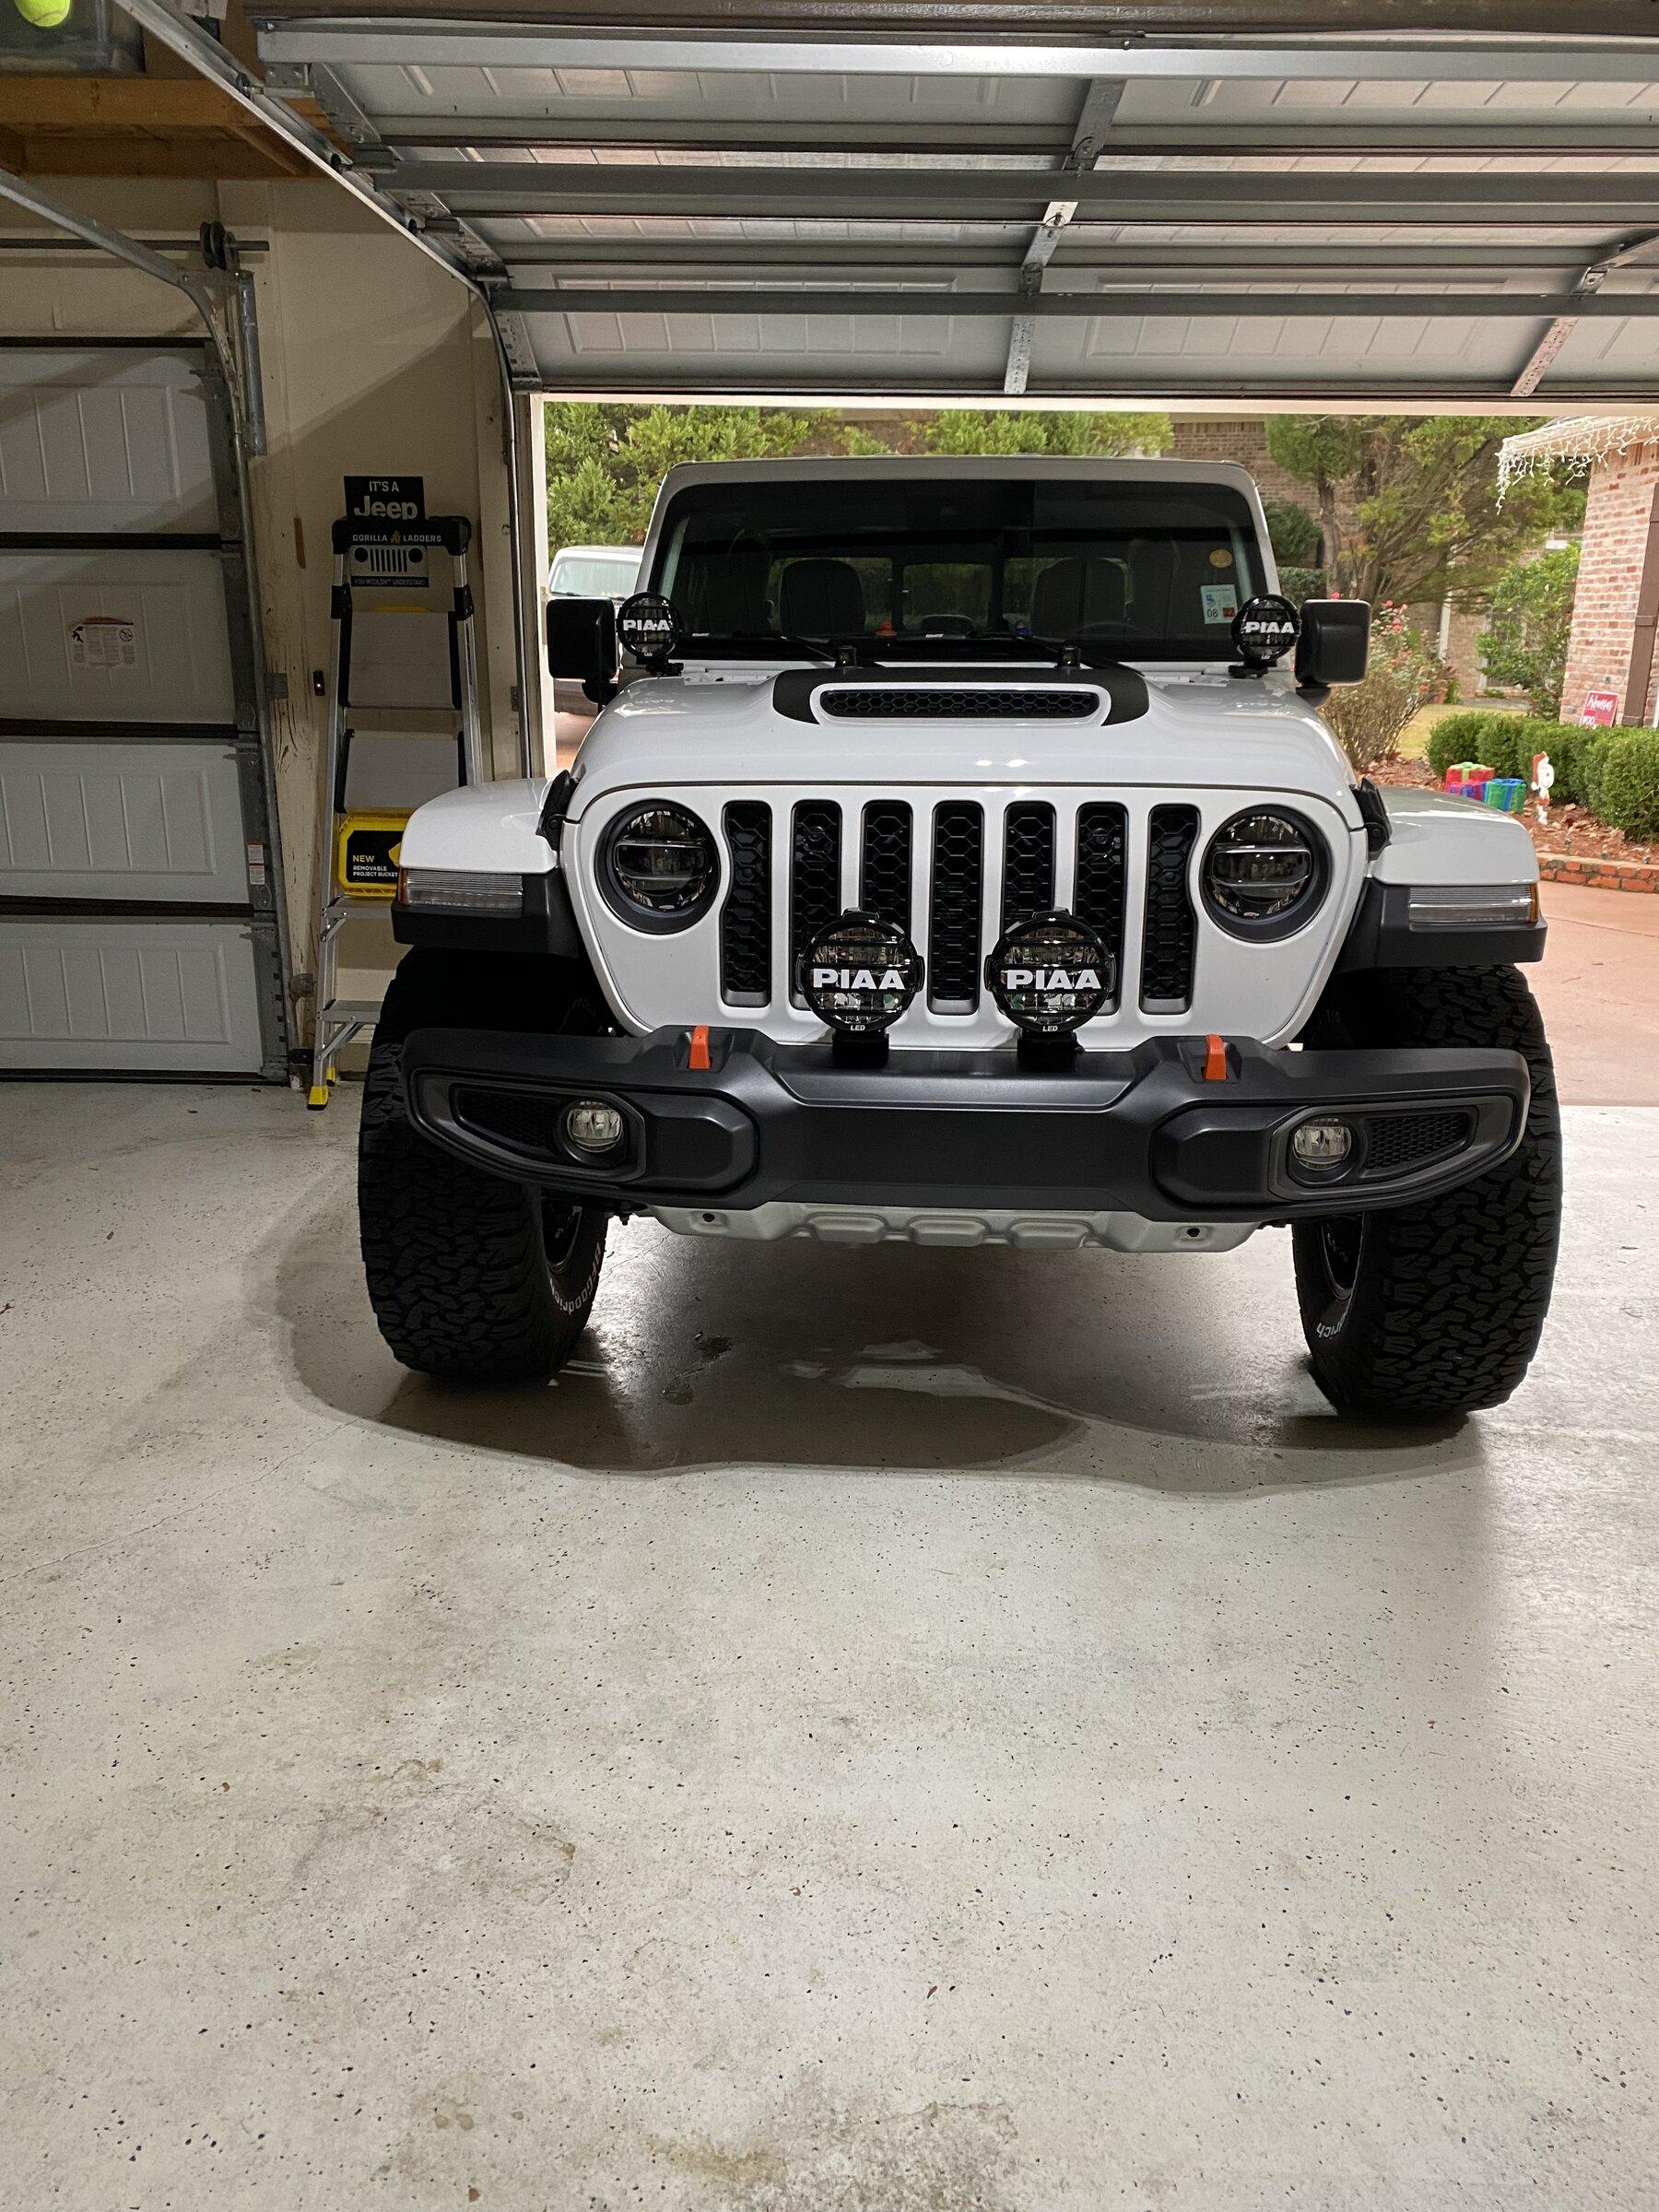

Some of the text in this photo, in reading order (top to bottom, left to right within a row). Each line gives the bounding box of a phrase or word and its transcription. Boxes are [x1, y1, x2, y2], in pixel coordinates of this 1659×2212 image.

[369, 481, 400, 492] IT'S A
[353, 495, 418, 521] Jeep
[352, 534, 442, 543] GORILLA LADDERS
[1206, 608, 1218, 618] 08
[622, 619, 671, 631] PIAA
[1245, 621, 1295, 634] PIAA
[352, 854, 375, 863] NEW
[812, 968, 906, 991] PIAA
[1006, 969, 1101, 991] PIAA
[849, 1024, 866, 1032] LED
[1041, 1025, 1059, 1033] LED
